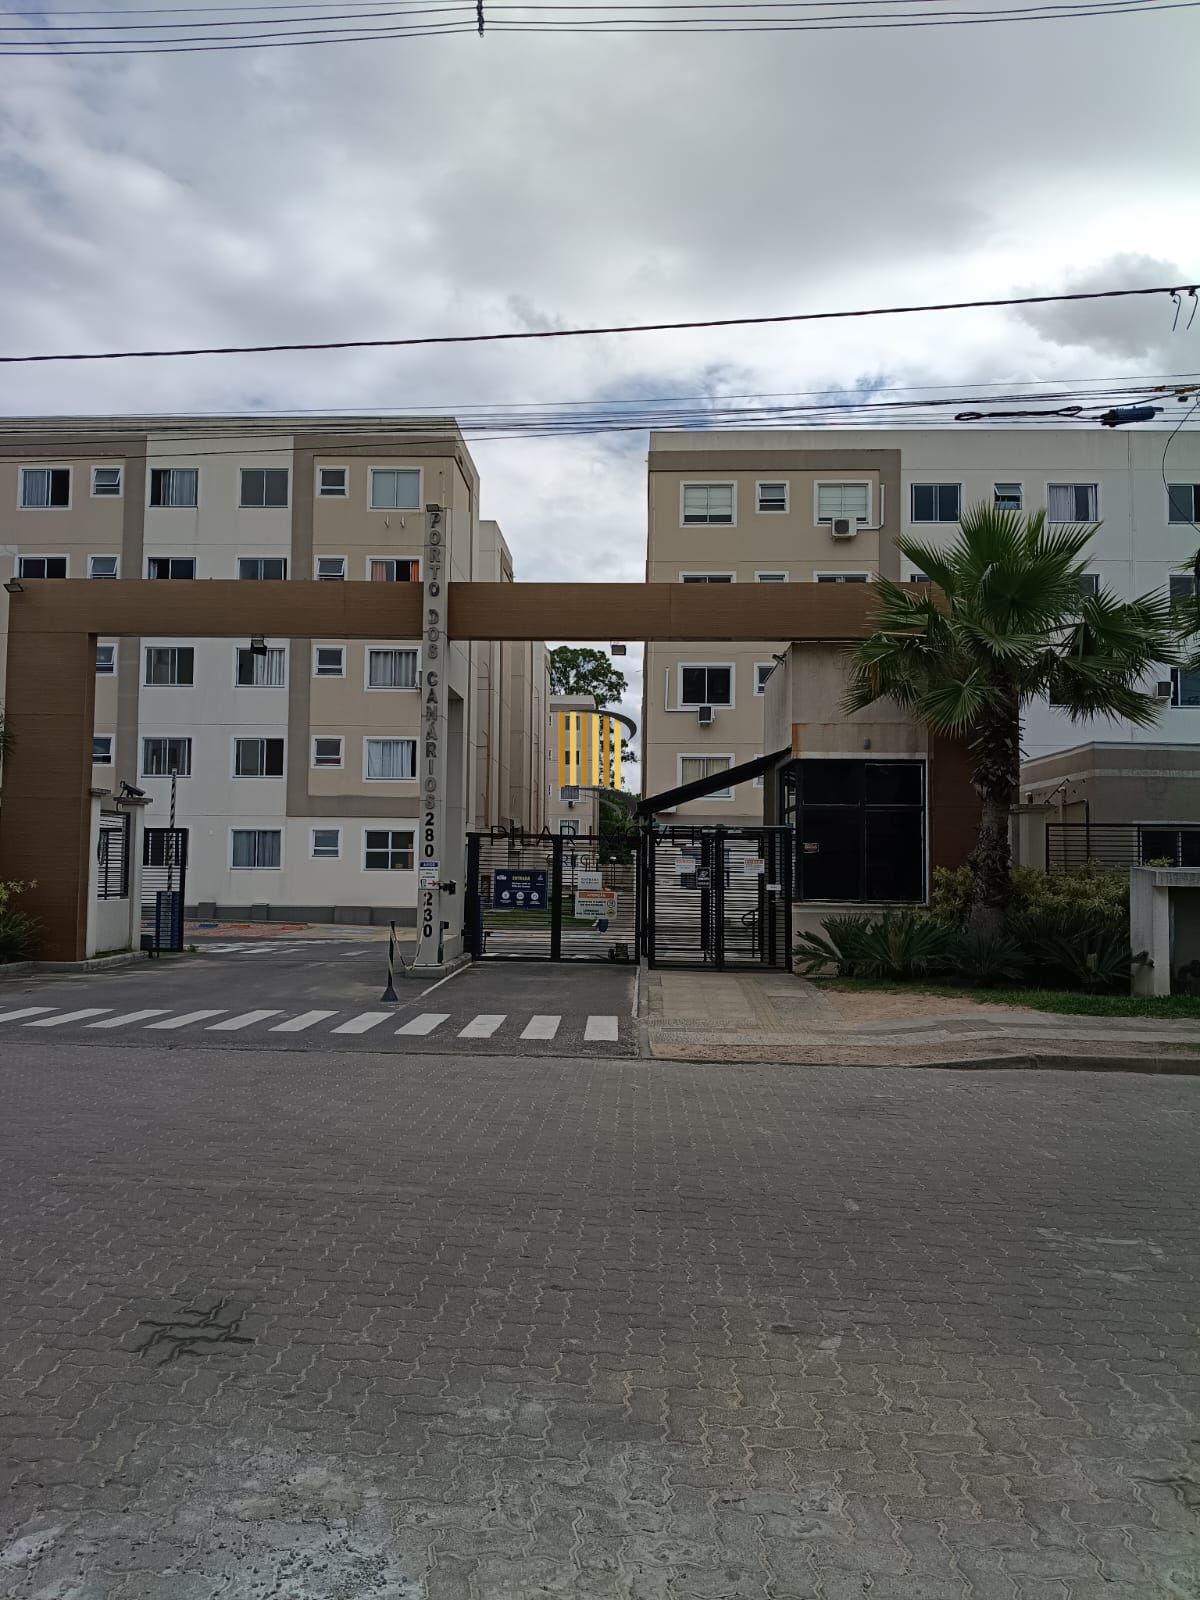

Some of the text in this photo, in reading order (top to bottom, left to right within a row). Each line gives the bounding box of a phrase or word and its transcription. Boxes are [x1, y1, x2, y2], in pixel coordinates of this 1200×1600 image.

[427, 512, 441, 598] PORTO
[427, 609, 440, 660] DOS
[424, 812, 435, 858] 280
[422, 891, 433, 938] 230
